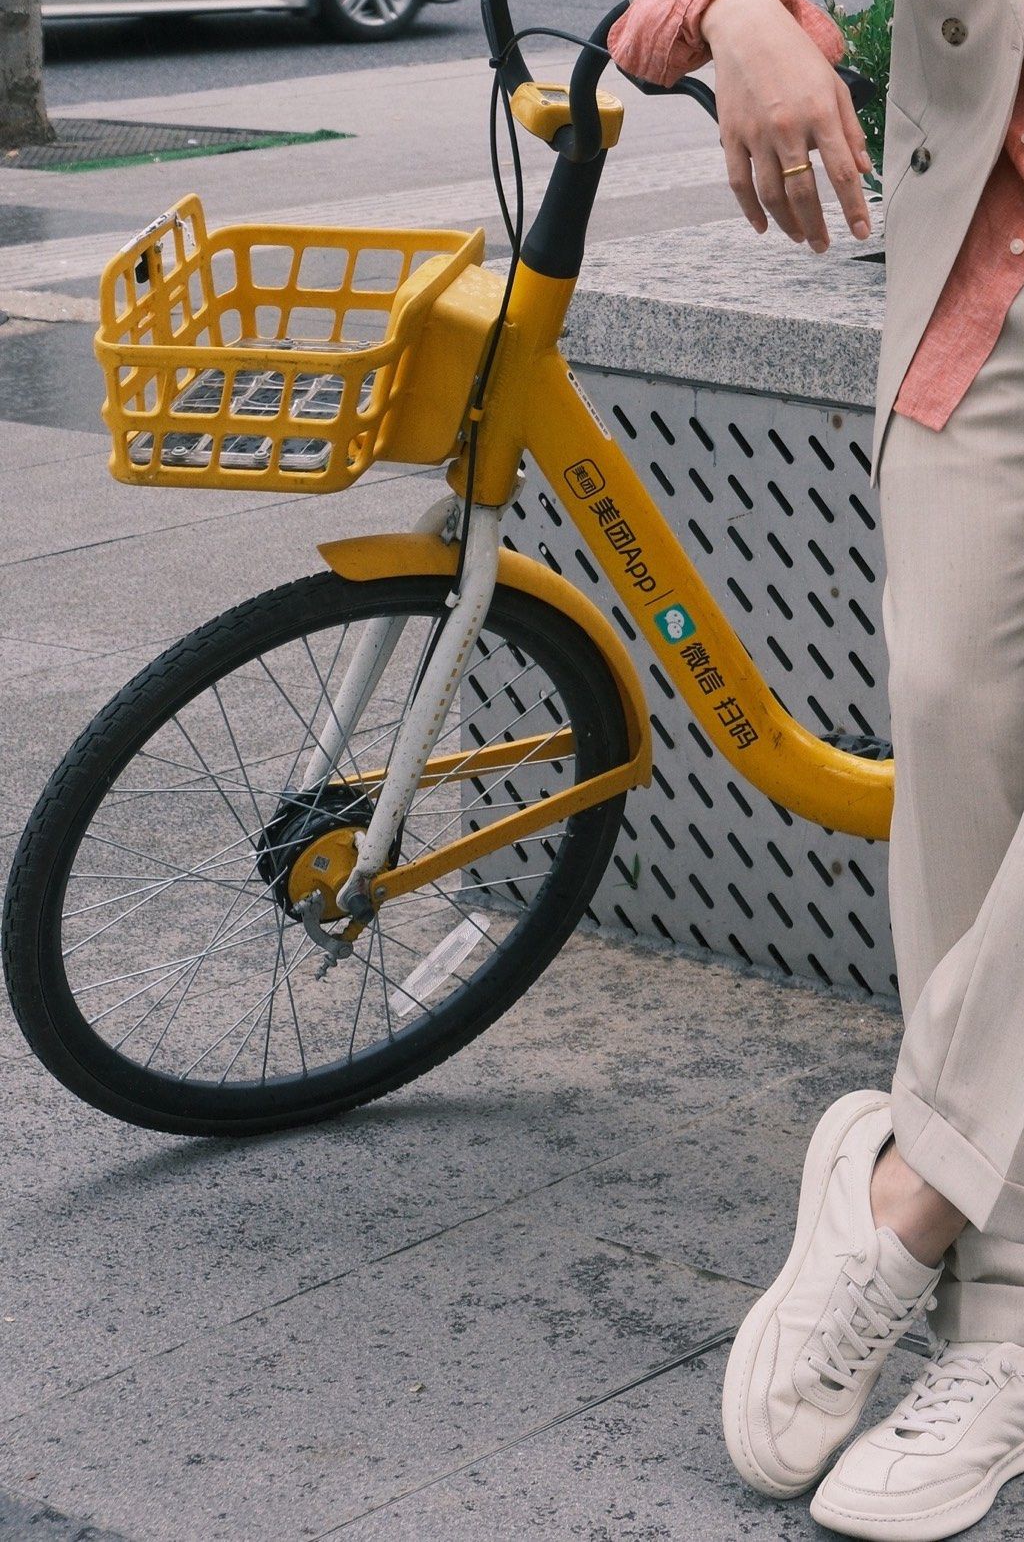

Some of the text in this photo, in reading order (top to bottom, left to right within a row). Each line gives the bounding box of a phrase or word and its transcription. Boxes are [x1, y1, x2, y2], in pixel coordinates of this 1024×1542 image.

[571, 465, 597, 495] 美团
[588, 496, 759, 750] 美团App 微信 扫码
